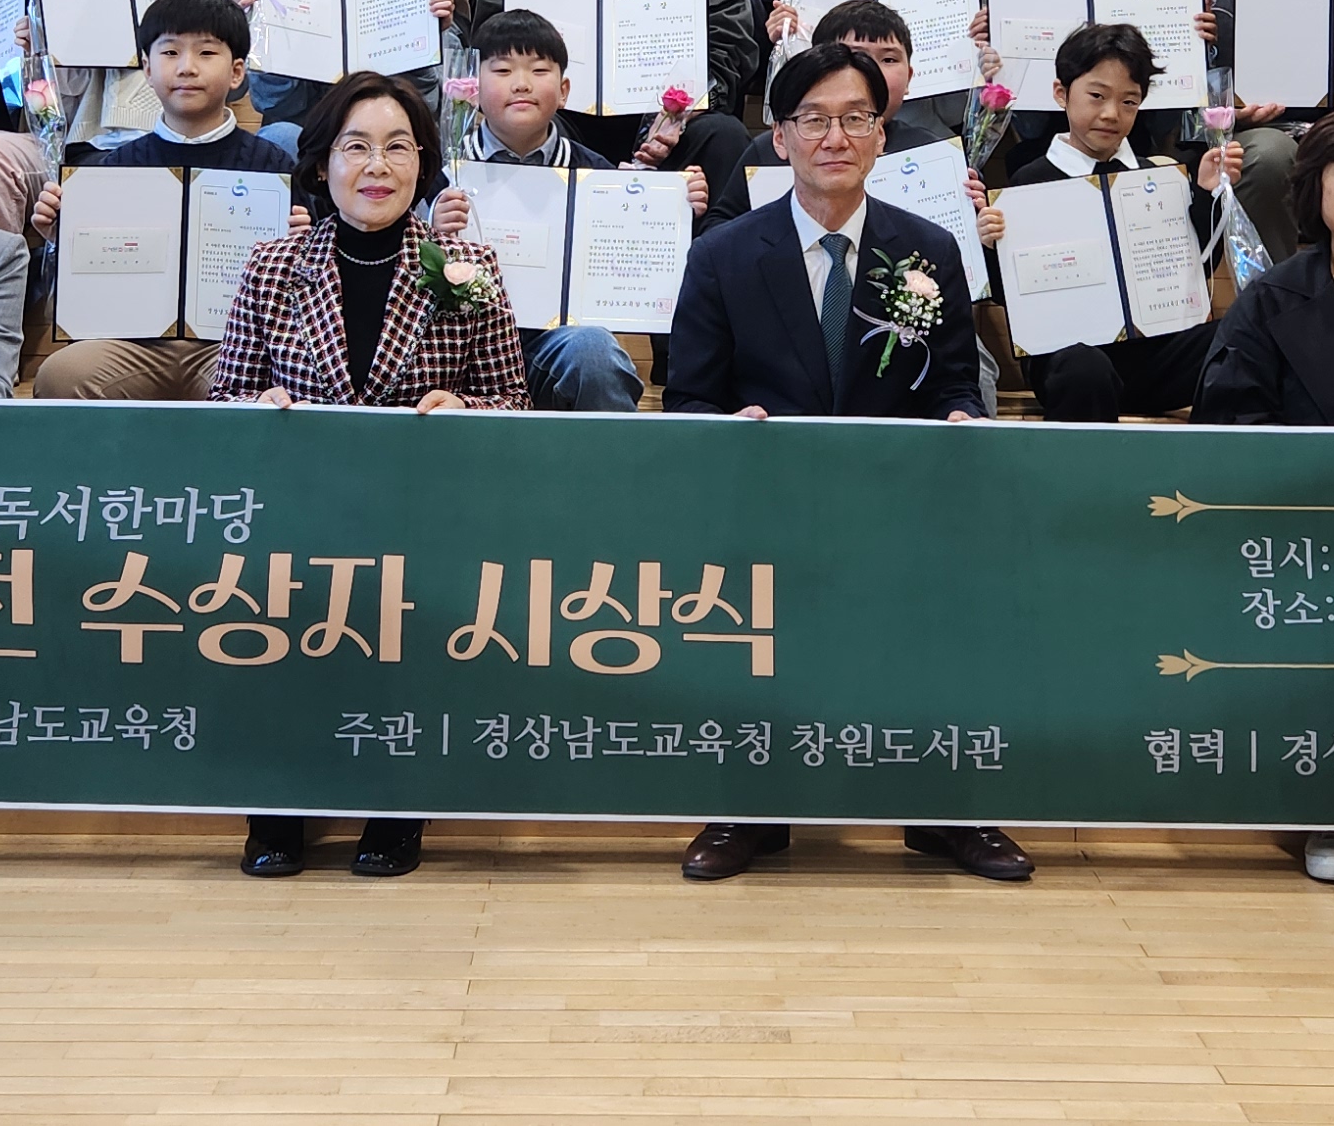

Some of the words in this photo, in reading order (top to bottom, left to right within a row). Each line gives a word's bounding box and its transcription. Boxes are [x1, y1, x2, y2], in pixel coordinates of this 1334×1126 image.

[1239, 537, 1331, 581] 일시:
[79, 550, 416, 666] 수상자
[445, 558, 775, 677] 시상식
[335, 711, 423, 757] 주관
[474, 713, 772, 766] 경상남도교육청
[793, 718, 1010, 771] 창원도서관
[1143, 728, 1225, 775] 협력
